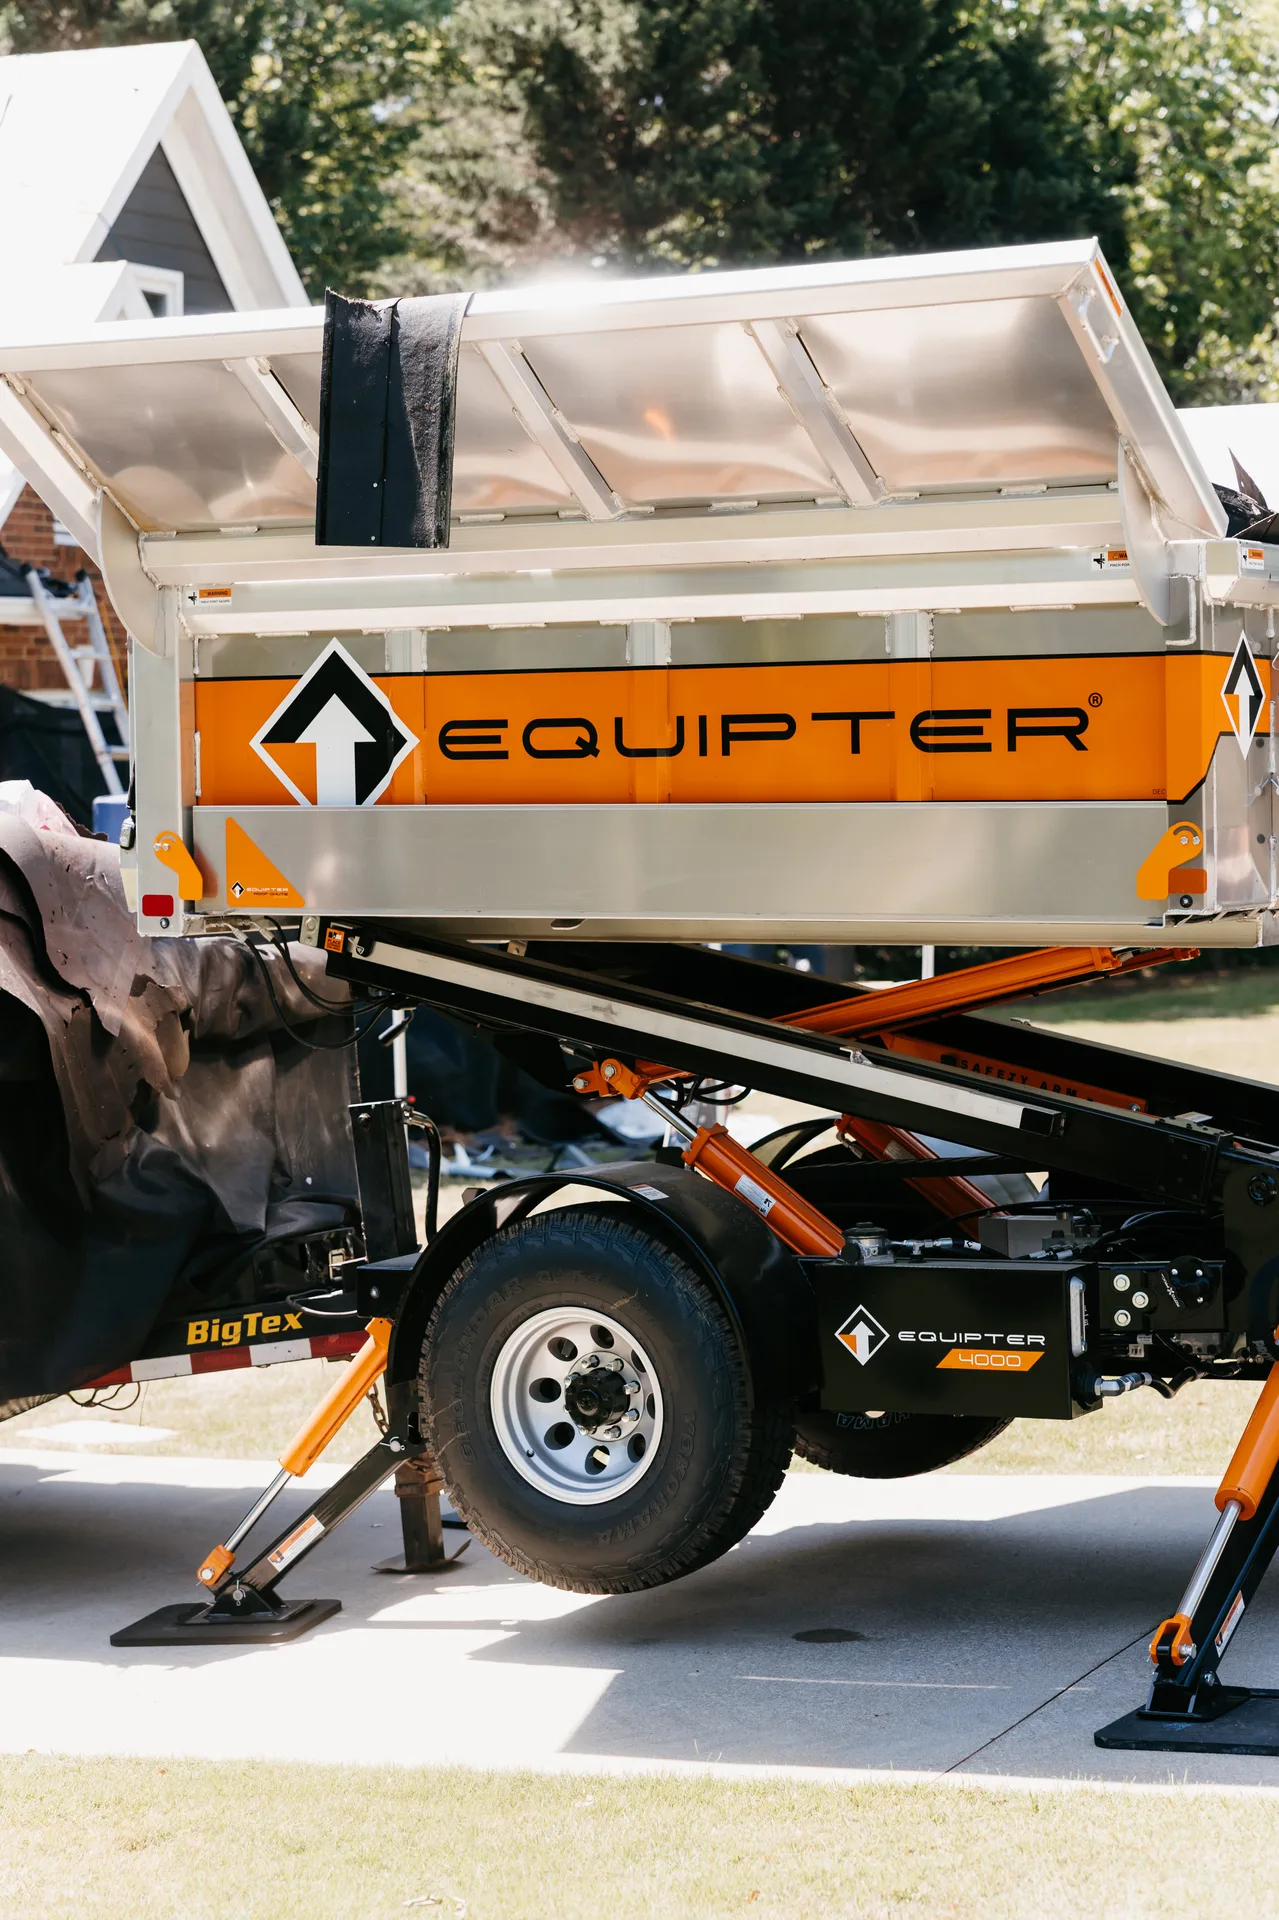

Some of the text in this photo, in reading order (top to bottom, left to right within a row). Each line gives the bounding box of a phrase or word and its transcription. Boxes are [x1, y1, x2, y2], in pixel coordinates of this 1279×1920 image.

[960, 1059, 1078, 1098] SAFETY ARM
[186, 1311, 303, 1346] BigTex
[898, 1330, 1046, 1346] EQUIPTER
[958, 1353, 1022, 1367] 4000
[597, 1409, 698, 1546] YOKOHAMA
